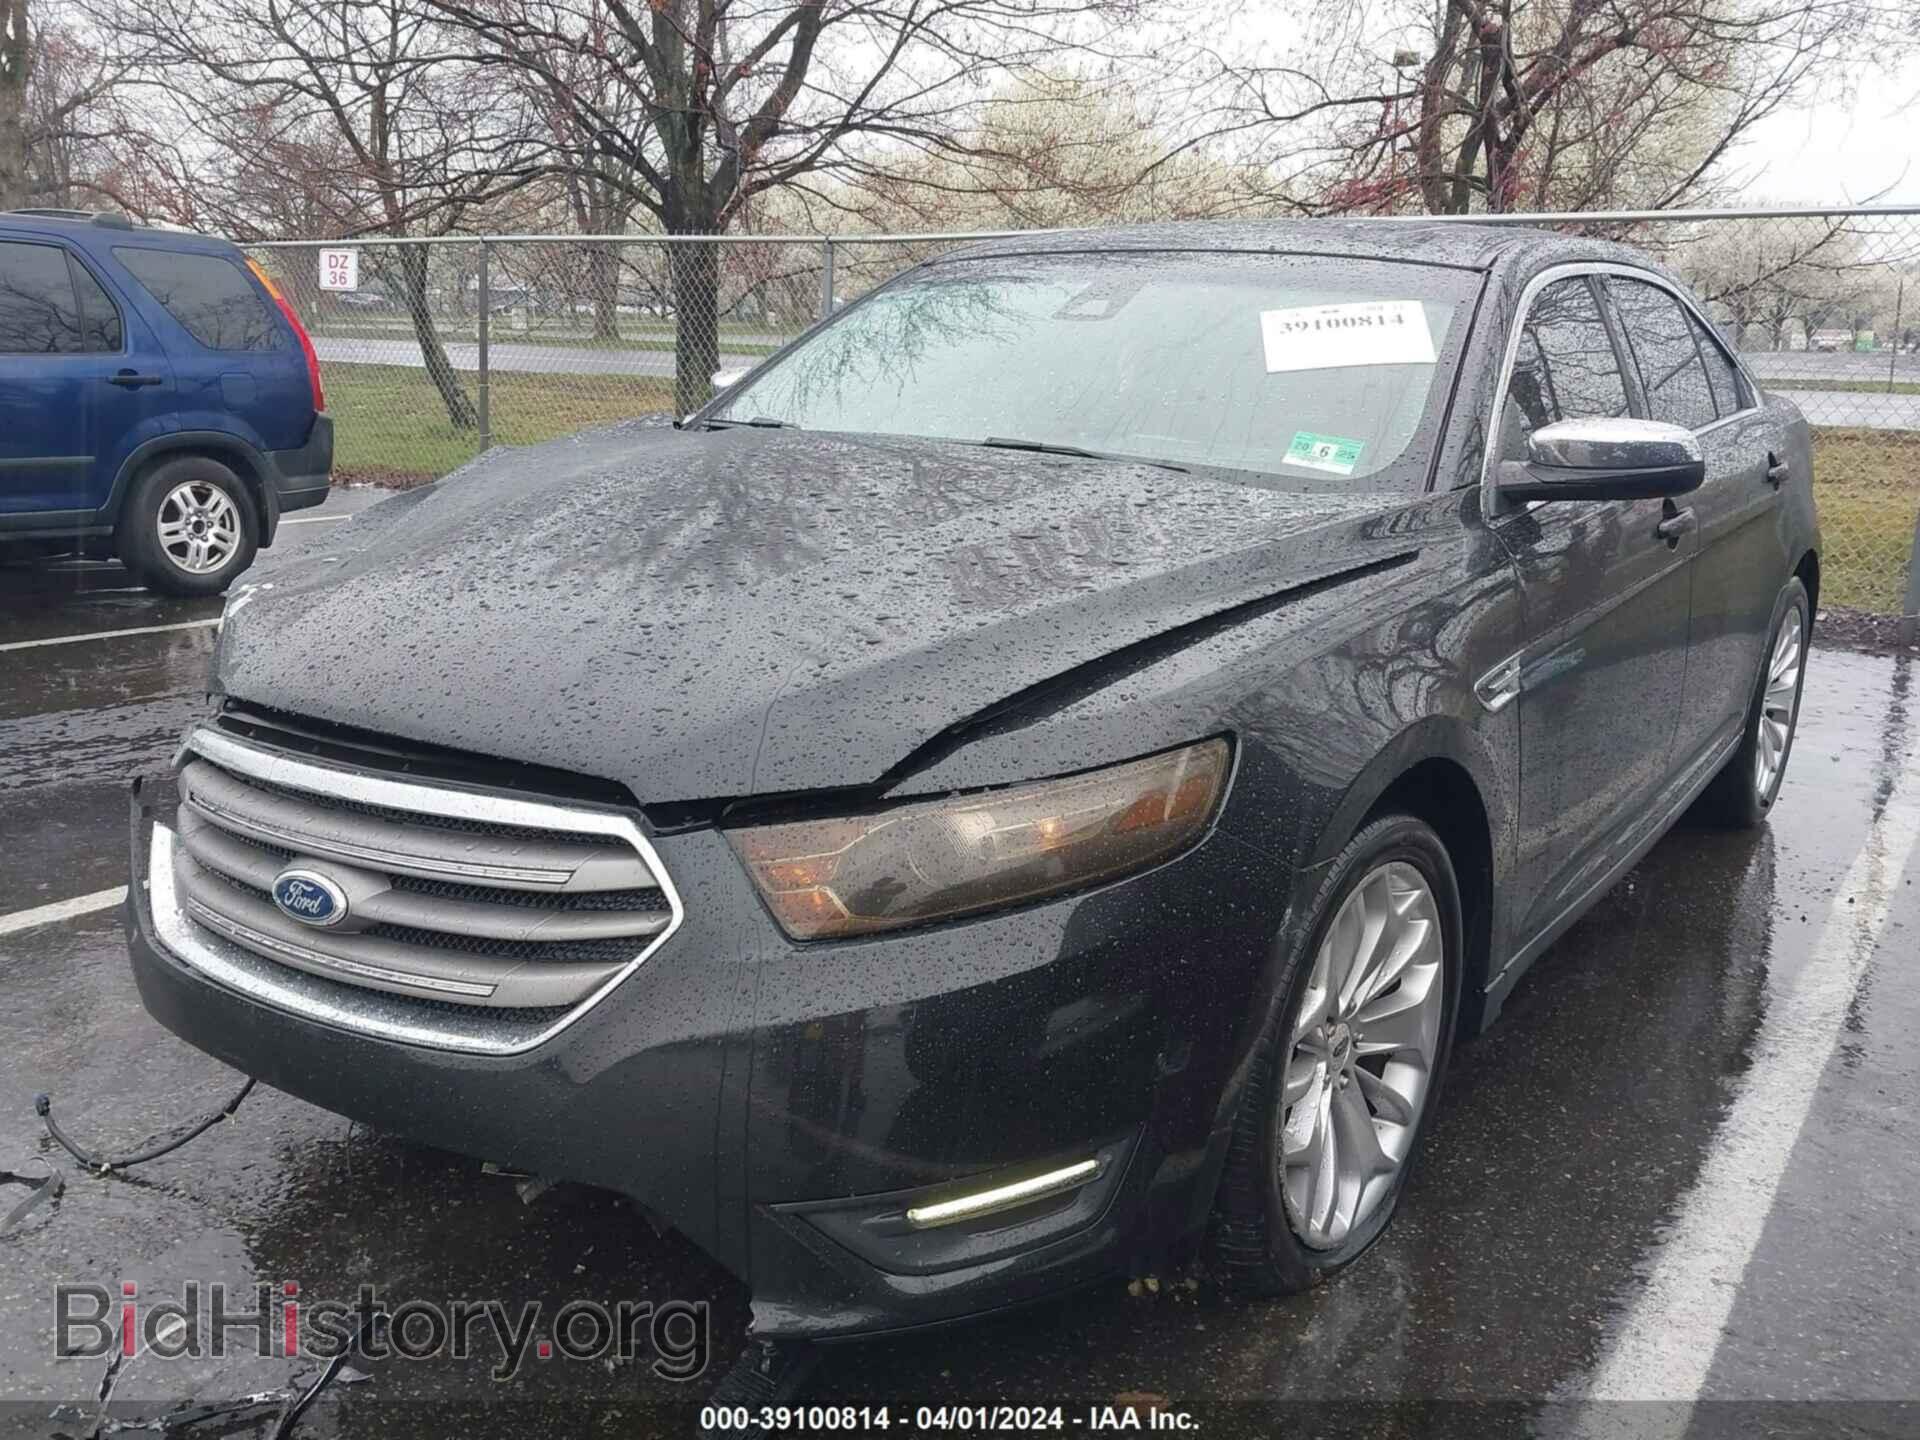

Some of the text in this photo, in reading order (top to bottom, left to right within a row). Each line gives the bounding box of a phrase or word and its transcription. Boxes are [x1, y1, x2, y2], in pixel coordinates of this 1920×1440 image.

[328, 254, 349, 269] DZ
[329, 270, 348, 285] 36
[1279, 313, 1405, 335] 39100814
[1319, 446, 1331, 458] 6
[284, 880, 323, 914] Ford
